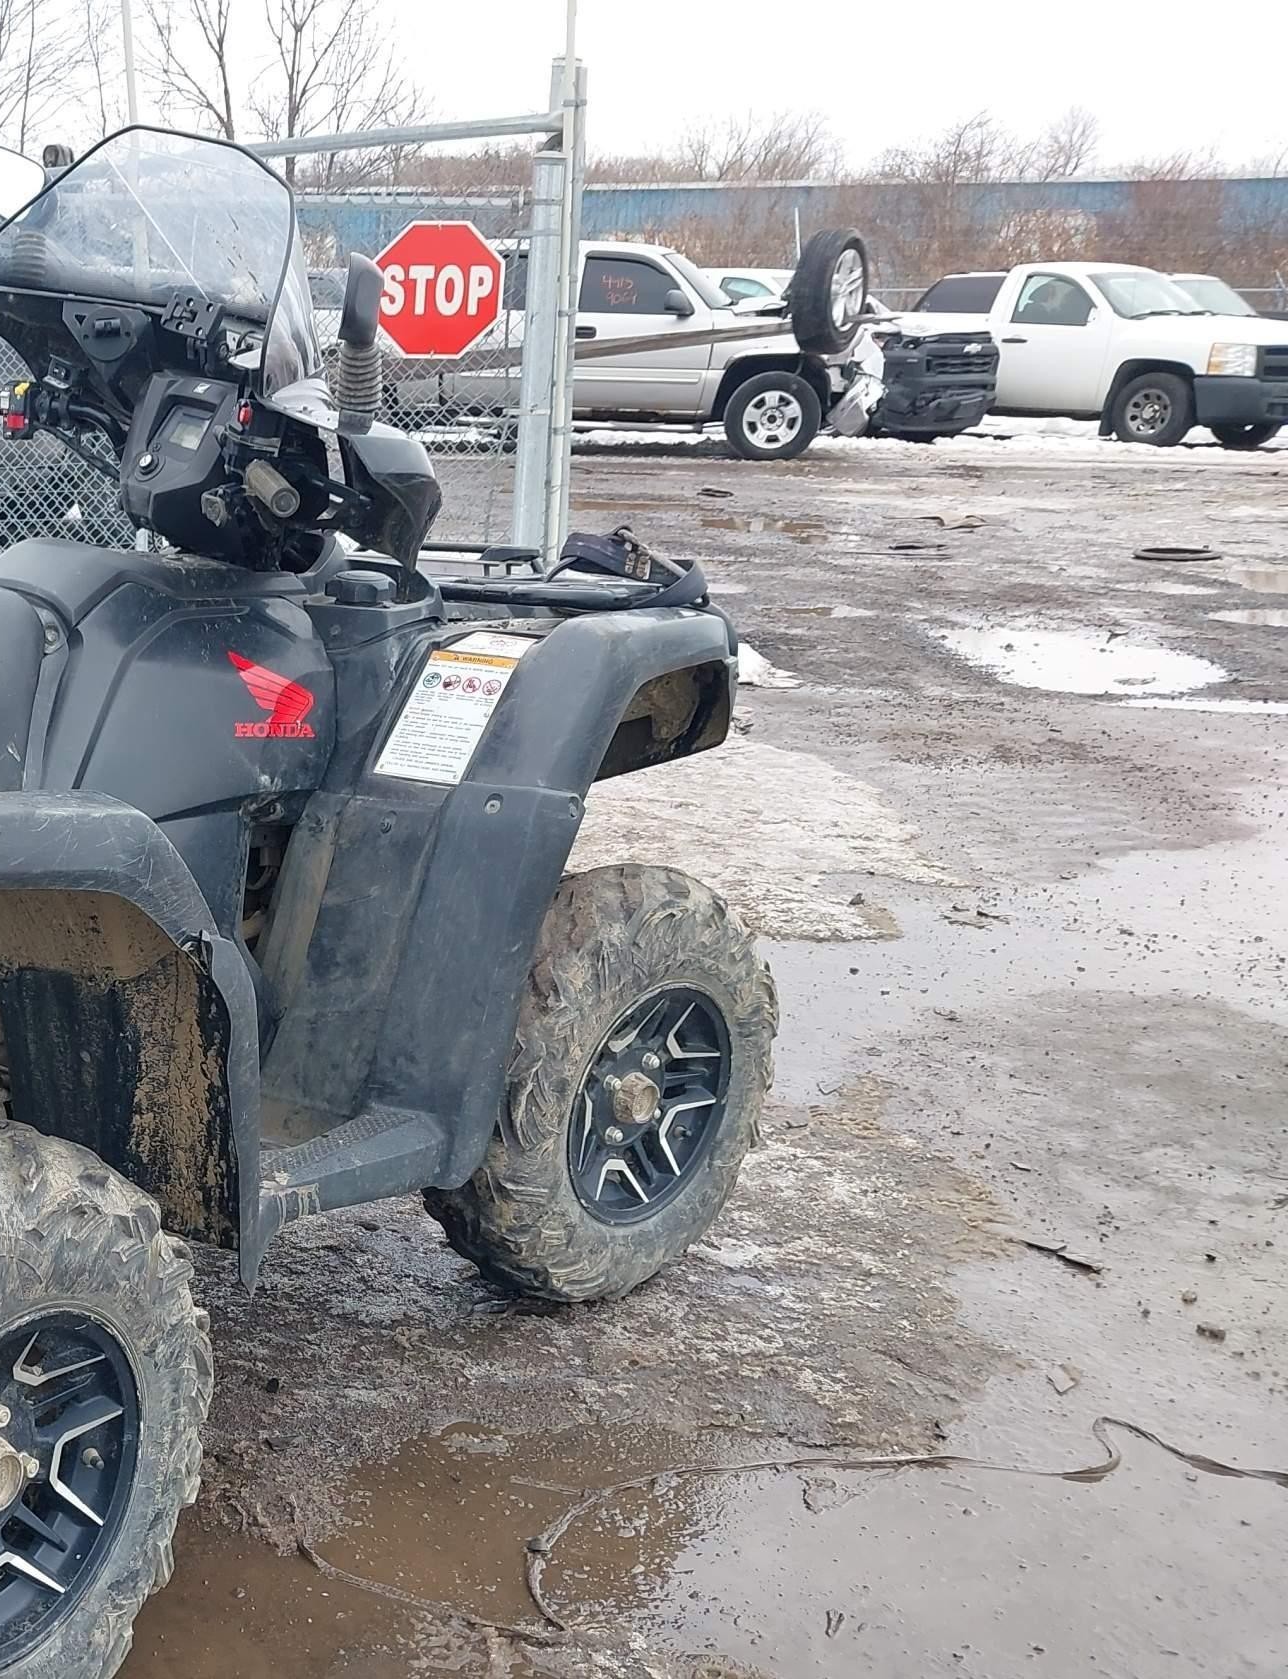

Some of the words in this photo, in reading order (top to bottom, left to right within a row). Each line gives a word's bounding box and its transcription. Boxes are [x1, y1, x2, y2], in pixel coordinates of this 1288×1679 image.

[380, 264, 494, 316] STOP
[462, 656, 494, 665] WARNING
[234, 722, 316, 738] HONDA
